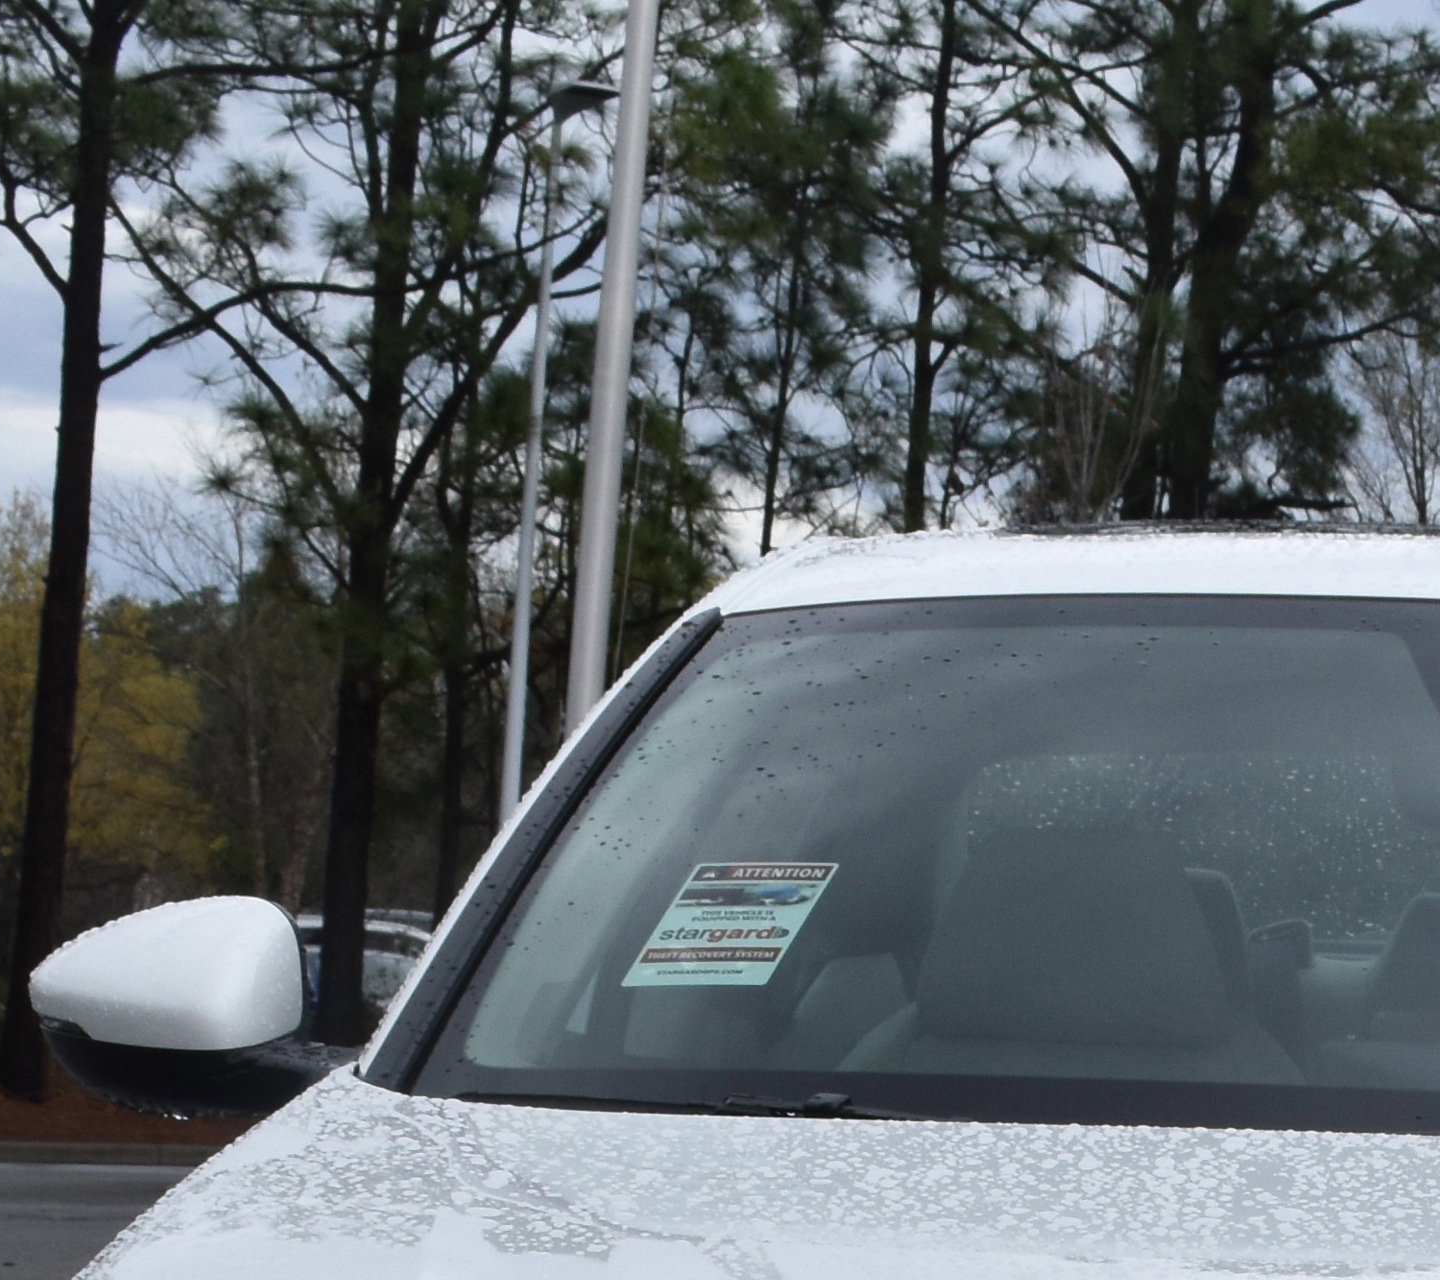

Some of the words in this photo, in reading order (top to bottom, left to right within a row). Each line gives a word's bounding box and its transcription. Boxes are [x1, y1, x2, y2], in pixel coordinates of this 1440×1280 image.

[732, 867, 825, 879] ATTENTION
[659, 926, 778, 943] stargard
[647, 951, 679, 960] THEFT
[679, 951, 732, 960] RECOVERY
[734, 951, 775, 959] SYSTEM
